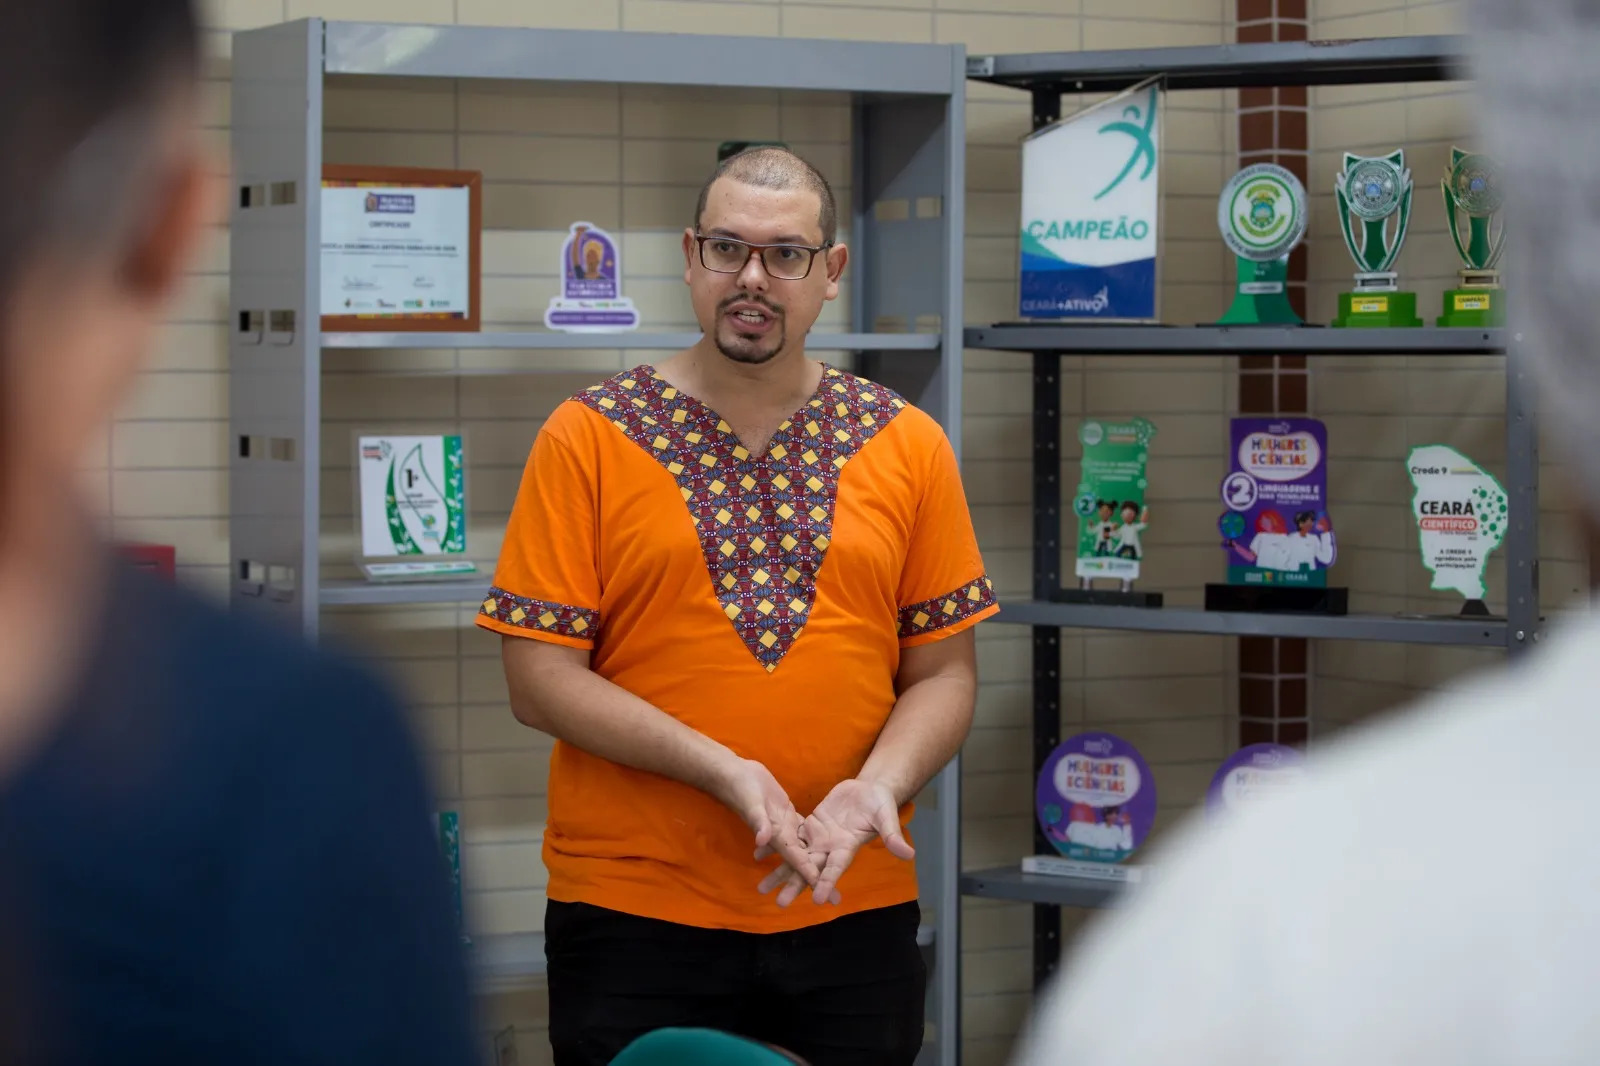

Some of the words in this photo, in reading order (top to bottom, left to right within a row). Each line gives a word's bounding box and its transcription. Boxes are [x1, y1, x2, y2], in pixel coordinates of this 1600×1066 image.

[1027, 216, 1149, 240] CAMPEÃO
[1251, 439, 1307, 451] MULHERES
[1259, 452, 1307, 466] CIÊNCIAS
[1411, 466, 1440, 475] Crede
[1441, 467, 1448, 475] 9
[1231, 477, 1251, 504] 2
[1420, 500, 1475, 516] CEARÁ
[1422, 519, 1475, 529] CIENTÍFICO
[1067, 759, 1125, 777] MULHERES
